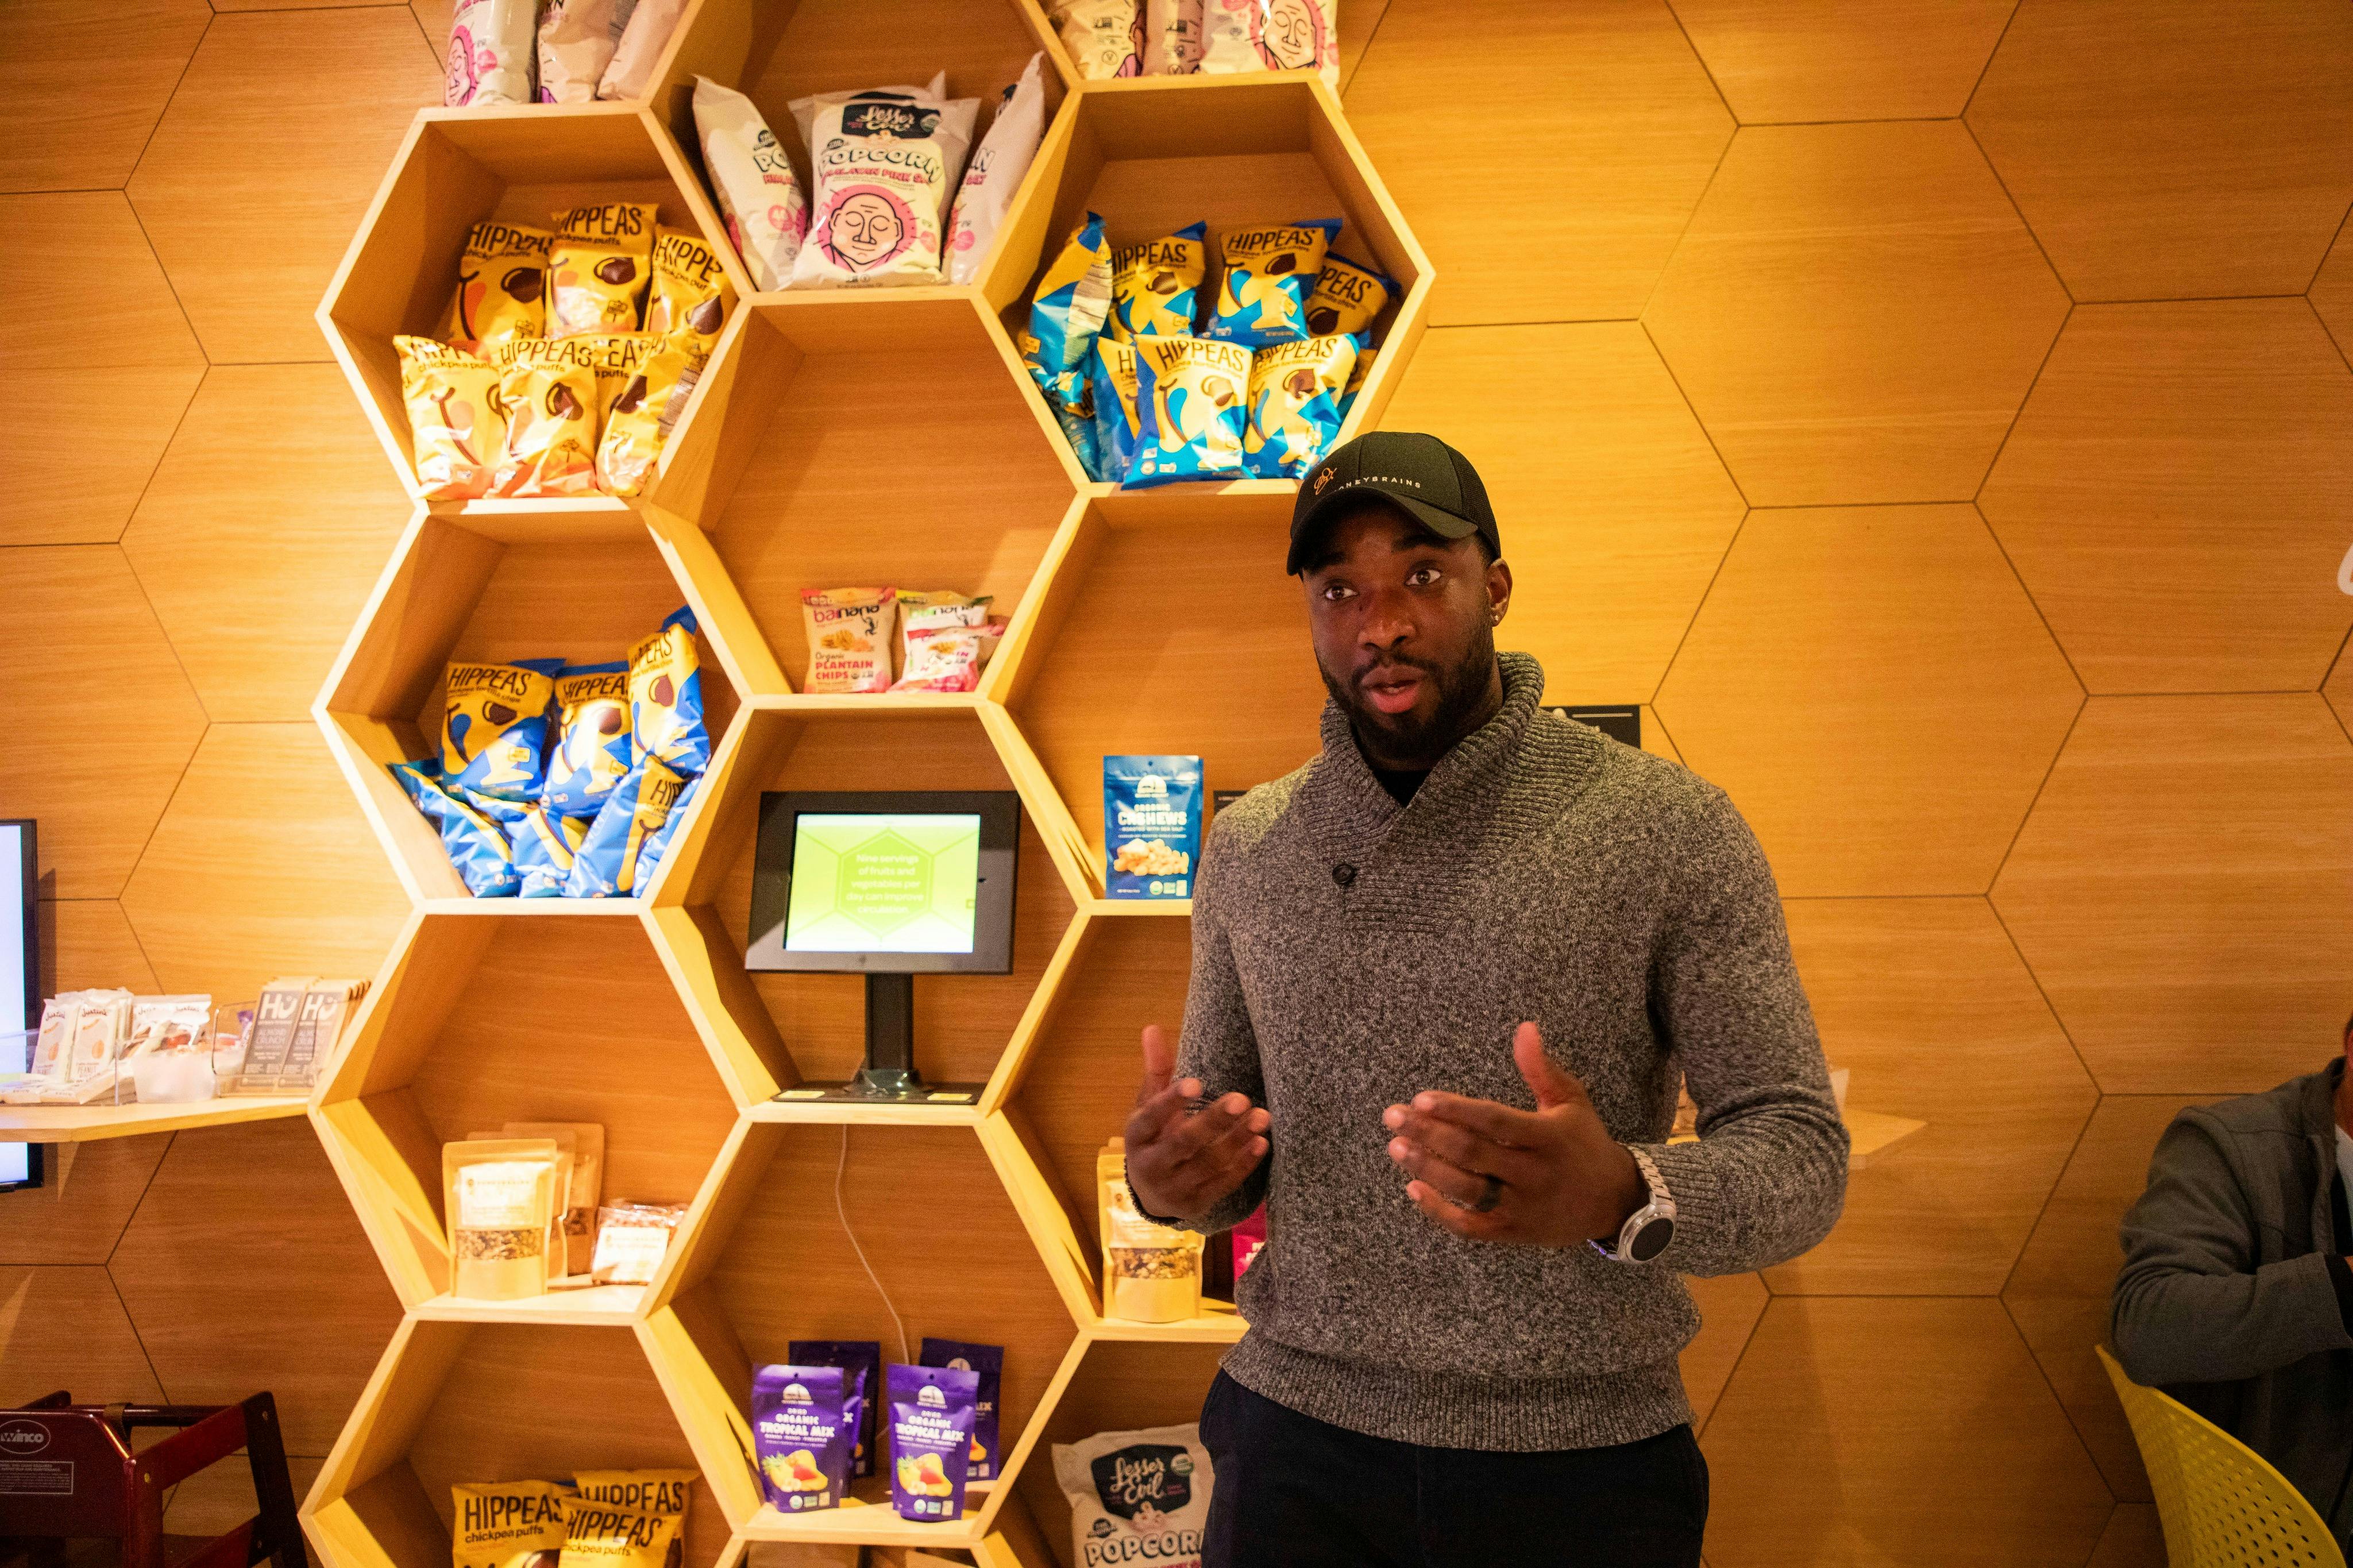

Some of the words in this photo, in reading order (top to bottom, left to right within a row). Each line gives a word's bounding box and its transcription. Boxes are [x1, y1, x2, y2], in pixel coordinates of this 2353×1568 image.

[560, 205, 642, 235] IPPEAS
[1227, 229, 1313, 250] HIPPEAS
[654, 237, 724, 283] HIPPE
[1156, 339, 1244, 372] HIPPEAS
[1335, 476, 1421, 492] ONEYBRAINS
[816, 661, 873, 670] PLANTAIN
[448, 667, 531, 696] HIPPEAS
[816, 671, 849, 679] CHIPS
[562, 674, 628, 698] HIPPEA
[1117, 810, 1187, 826] CASHEWS
[856, 853, 878, 862] Nine
[880, 855, 919, 866] servings
[858, 866, 870, 875] of
[870, 866, 895, 875] fruits
[897, 867, 916, 875] and
[851, 880, 902, 890] vegetables
[904, 882, 921, 890] per
[846, 892, 863, 901] day
[884, 893, 924, 902] improve
[759, 1421, 809, 1436] TROPICAL
[809, 1425, 835, 1438] MIX
[895, 1422, 940, 1440] TROPICAL
[940, 1428, 966, 1443] MIX
[465, 1494, 564, 1532] HIPPEAS
[465, 1530, 514, 1544] chickpea
[515, 1524, 545, 1538] puffs
[603, 1545, 631, 1557] puffs
[1084, 1529, 1204, 1567] POPCOR
